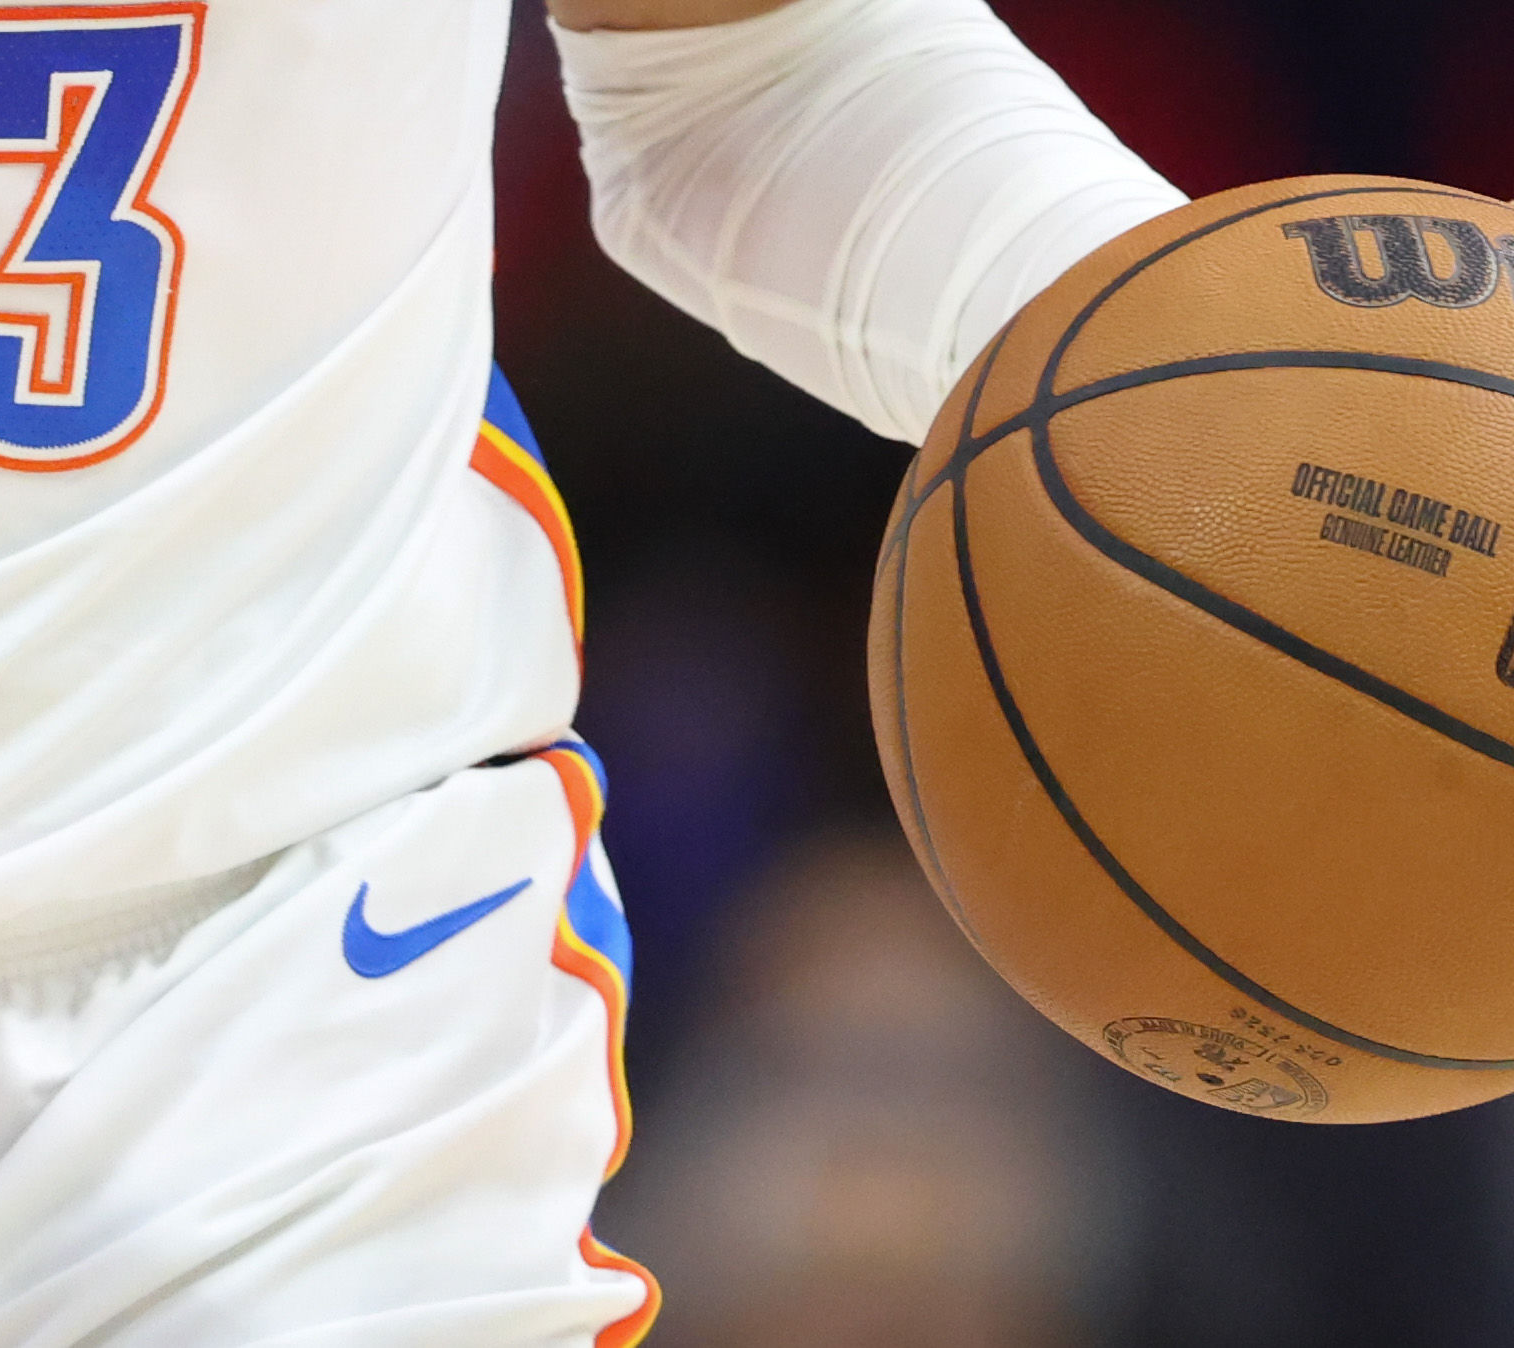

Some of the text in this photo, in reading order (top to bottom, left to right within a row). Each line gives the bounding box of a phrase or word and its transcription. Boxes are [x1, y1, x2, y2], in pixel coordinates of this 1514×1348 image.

[1291, 462, 1502, 558] OFFICIAL GAME BALL
[1320, 513, 1452, 577] GENUINE LEATHER
